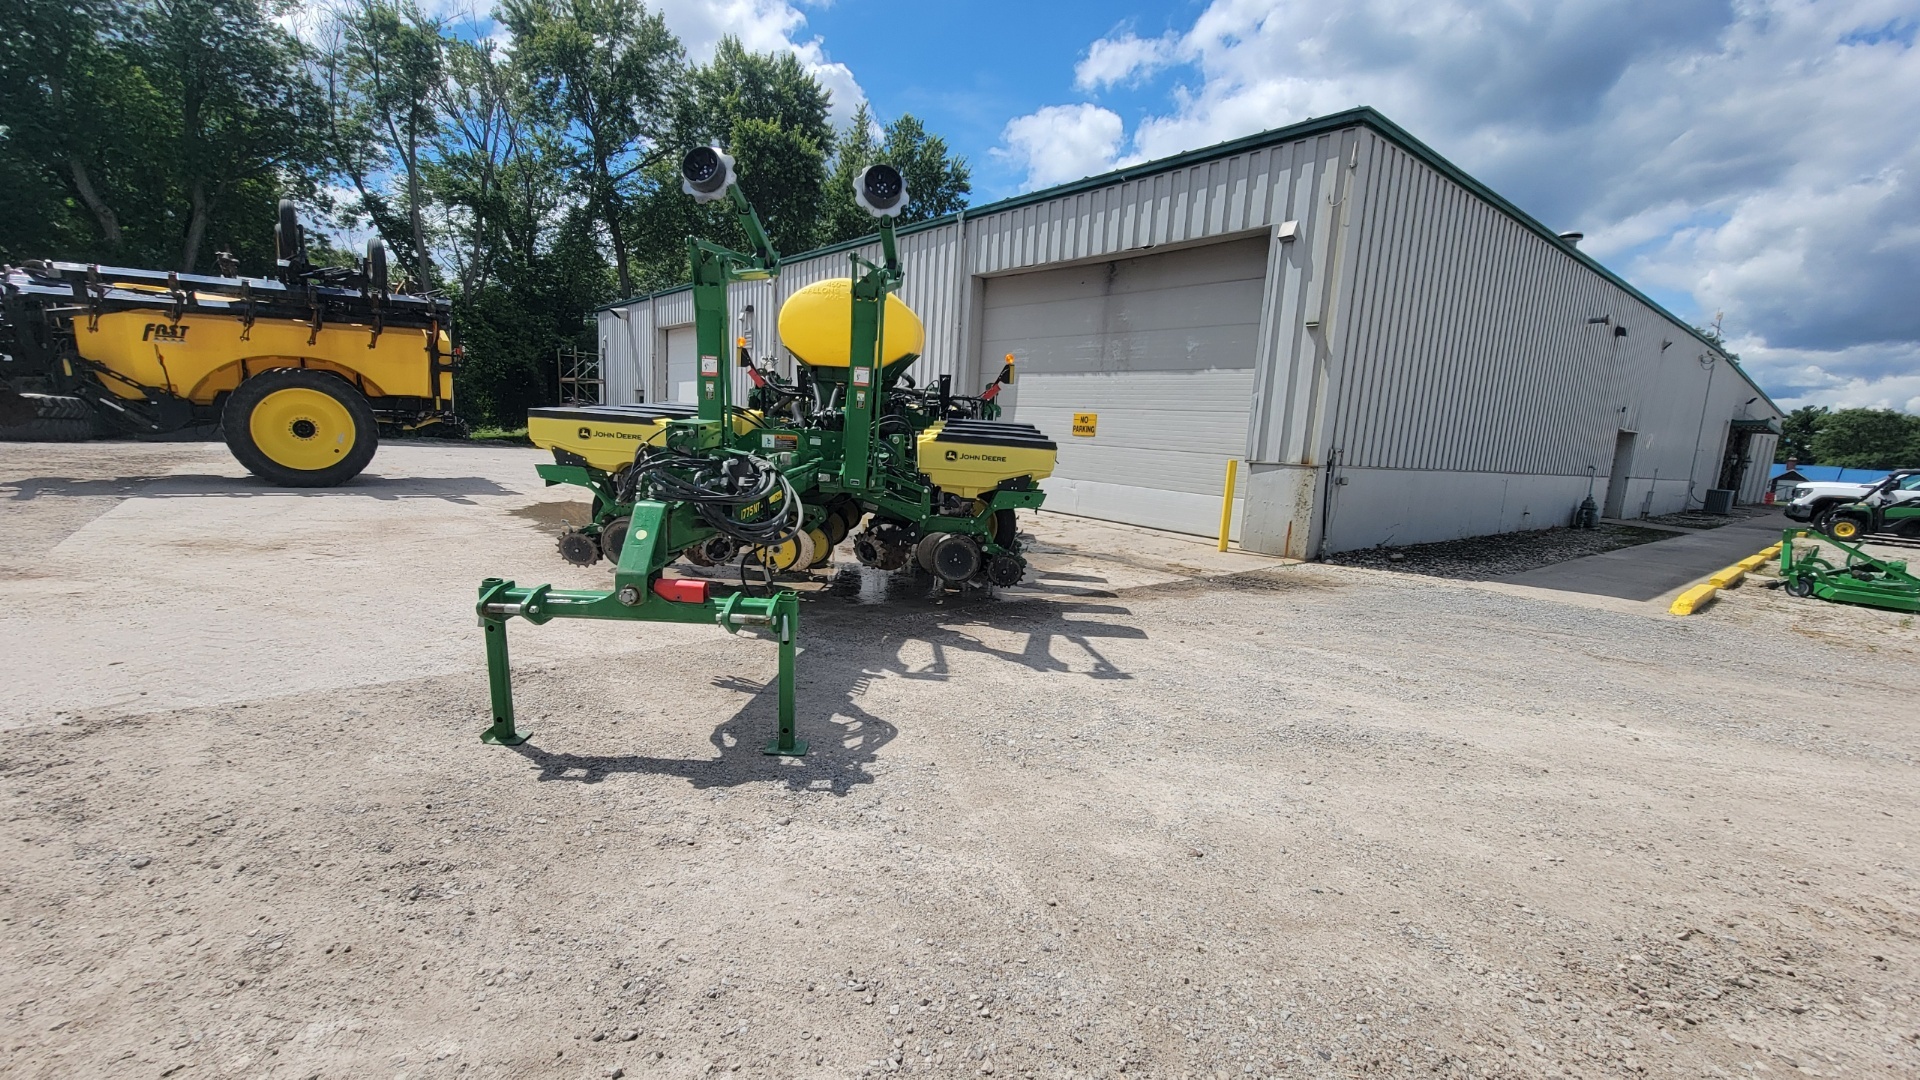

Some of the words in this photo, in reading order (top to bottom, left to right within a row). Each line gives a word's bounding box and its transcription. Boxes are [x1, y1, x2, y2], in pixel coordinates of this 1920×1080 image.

[142, 323, 190, 341] FAST
[1080, 416, 1089, 424] NO
[1072, 425, 1095, 433] PARKING
[616, 432, 642, 440] DEERE
[959, 453, 980, 461] JOHN
